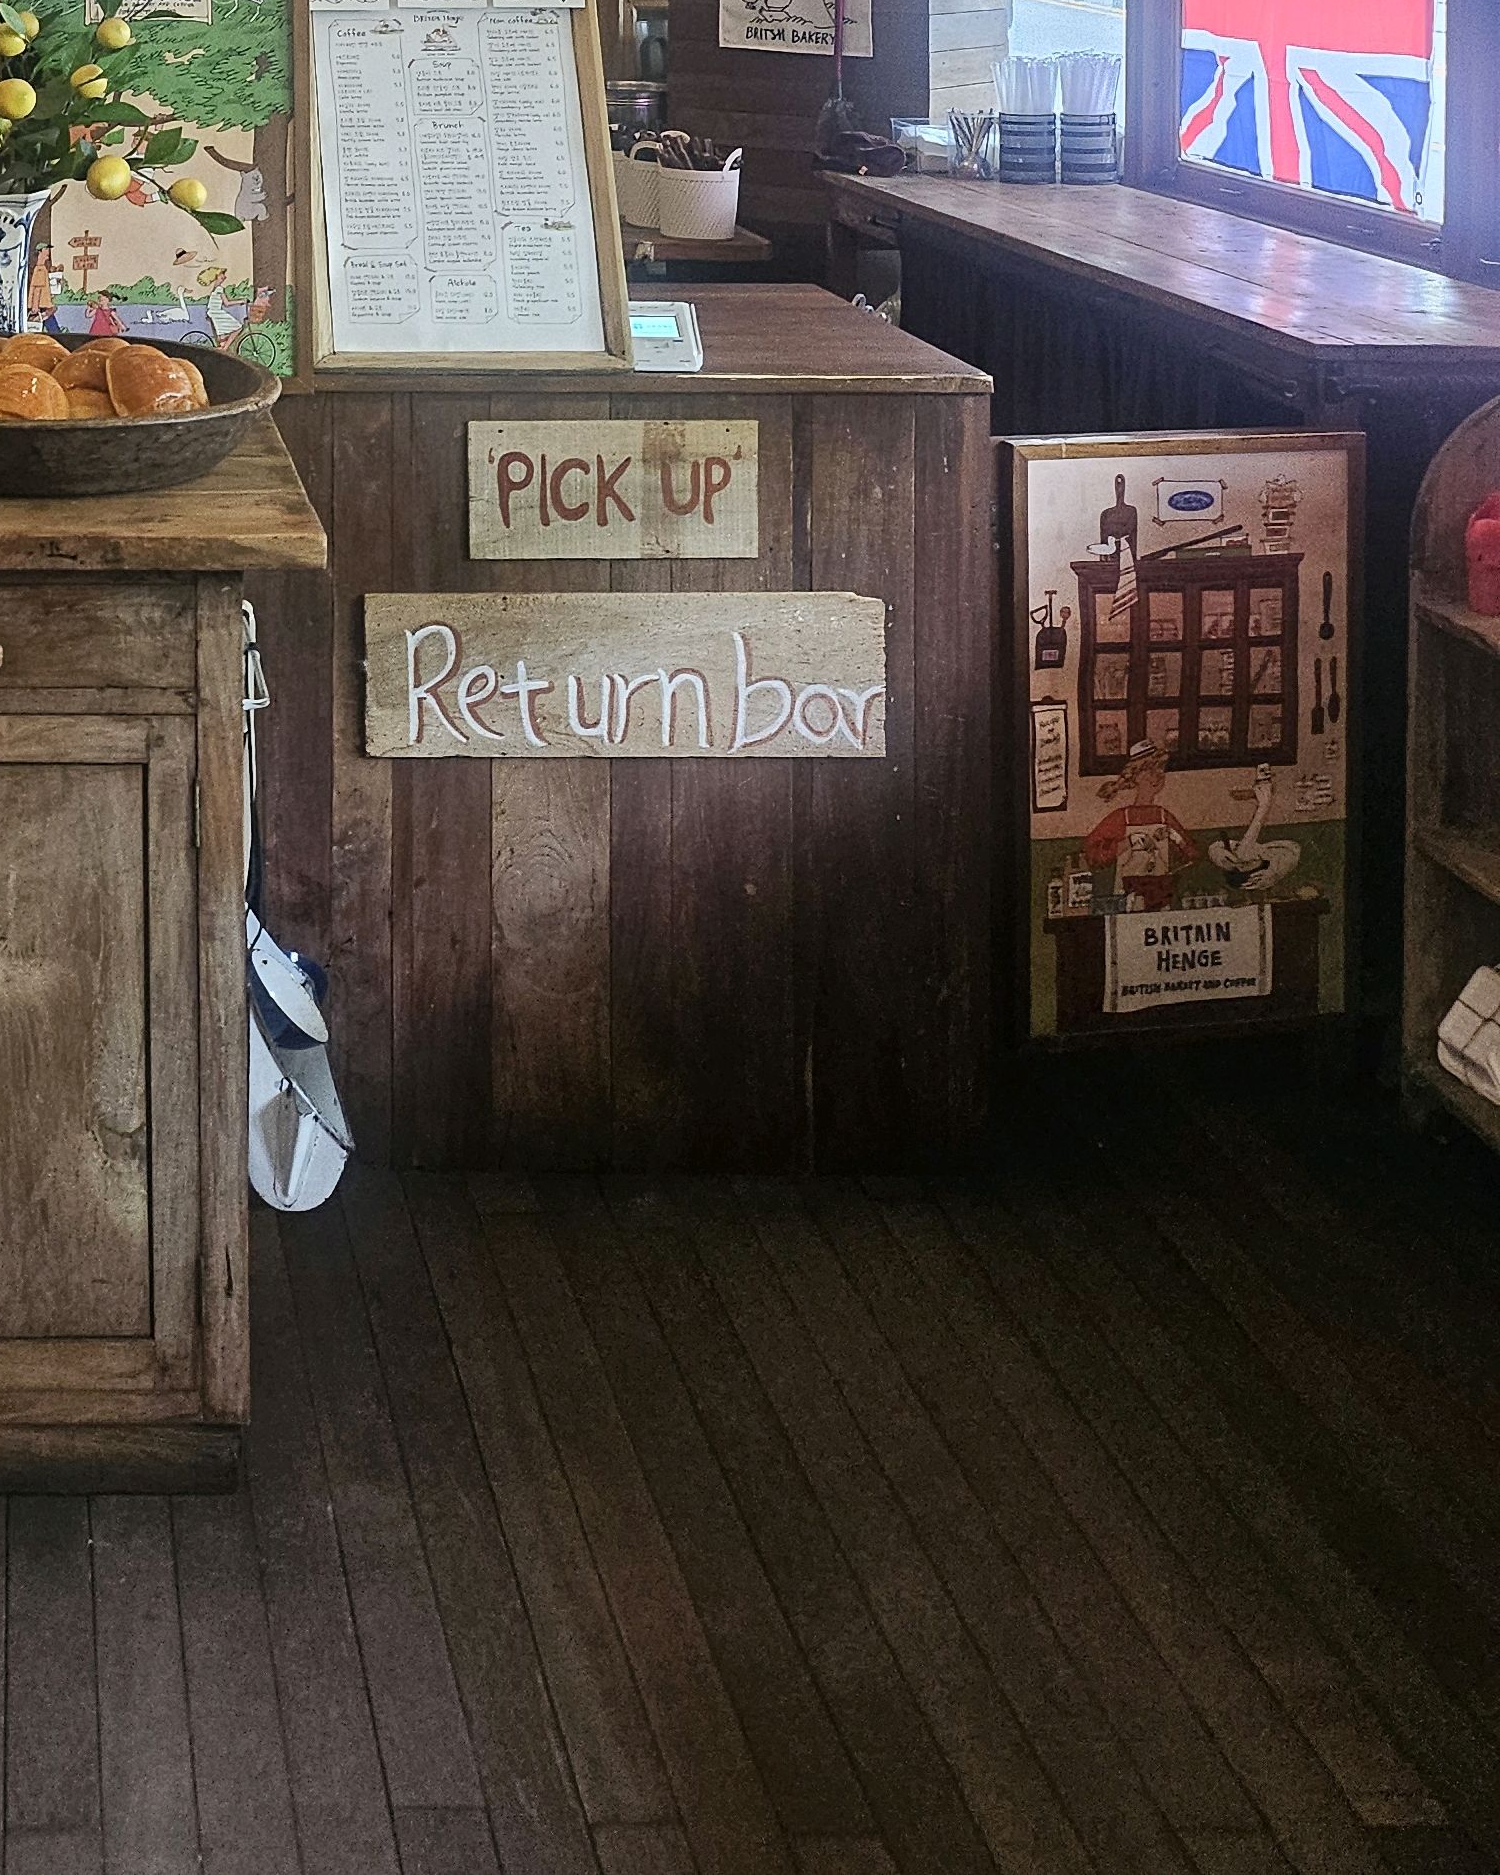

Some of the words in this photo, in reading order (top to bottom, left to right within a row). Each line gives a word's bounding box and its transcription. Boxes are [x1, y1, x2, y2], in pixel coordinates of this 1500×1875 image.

[337, 28, 366, 37] Coffee
[404, 619, 714, 749] Return
[727, 630, 886, 755] bar
[1143, 921, 1232, 947] BRITAIN
[1156, 949, 1223, 973] HENGE
